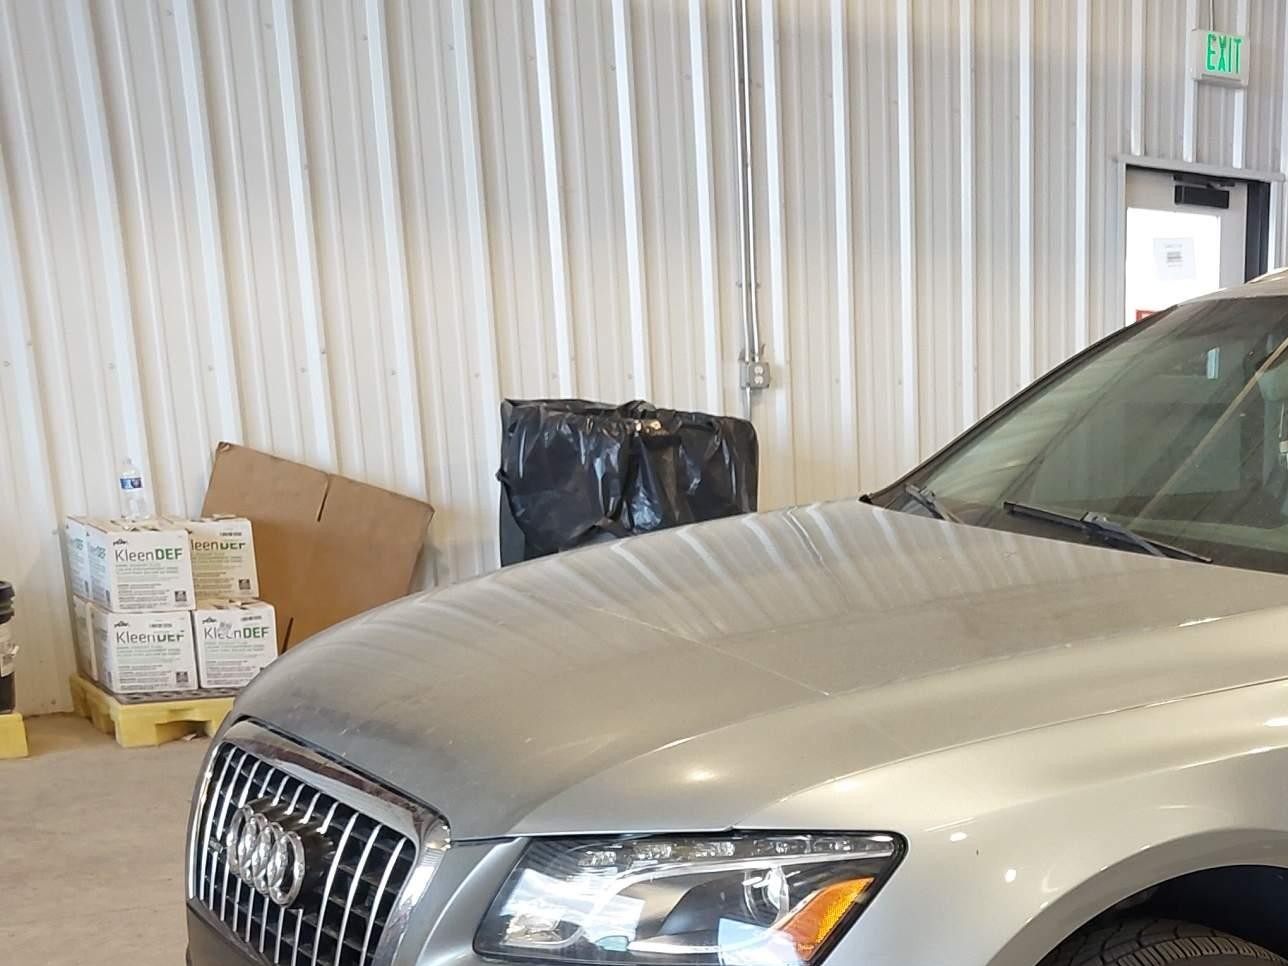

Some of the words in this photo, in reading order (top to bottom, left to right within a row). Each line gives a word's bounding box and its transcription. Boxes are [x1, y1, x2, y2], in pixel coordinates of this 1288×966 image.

[1207, 33, 1242, 74] EXIT
[191, 539, 246, 551] leenDEF
[114, 547, 183, 562] KleenDEF
